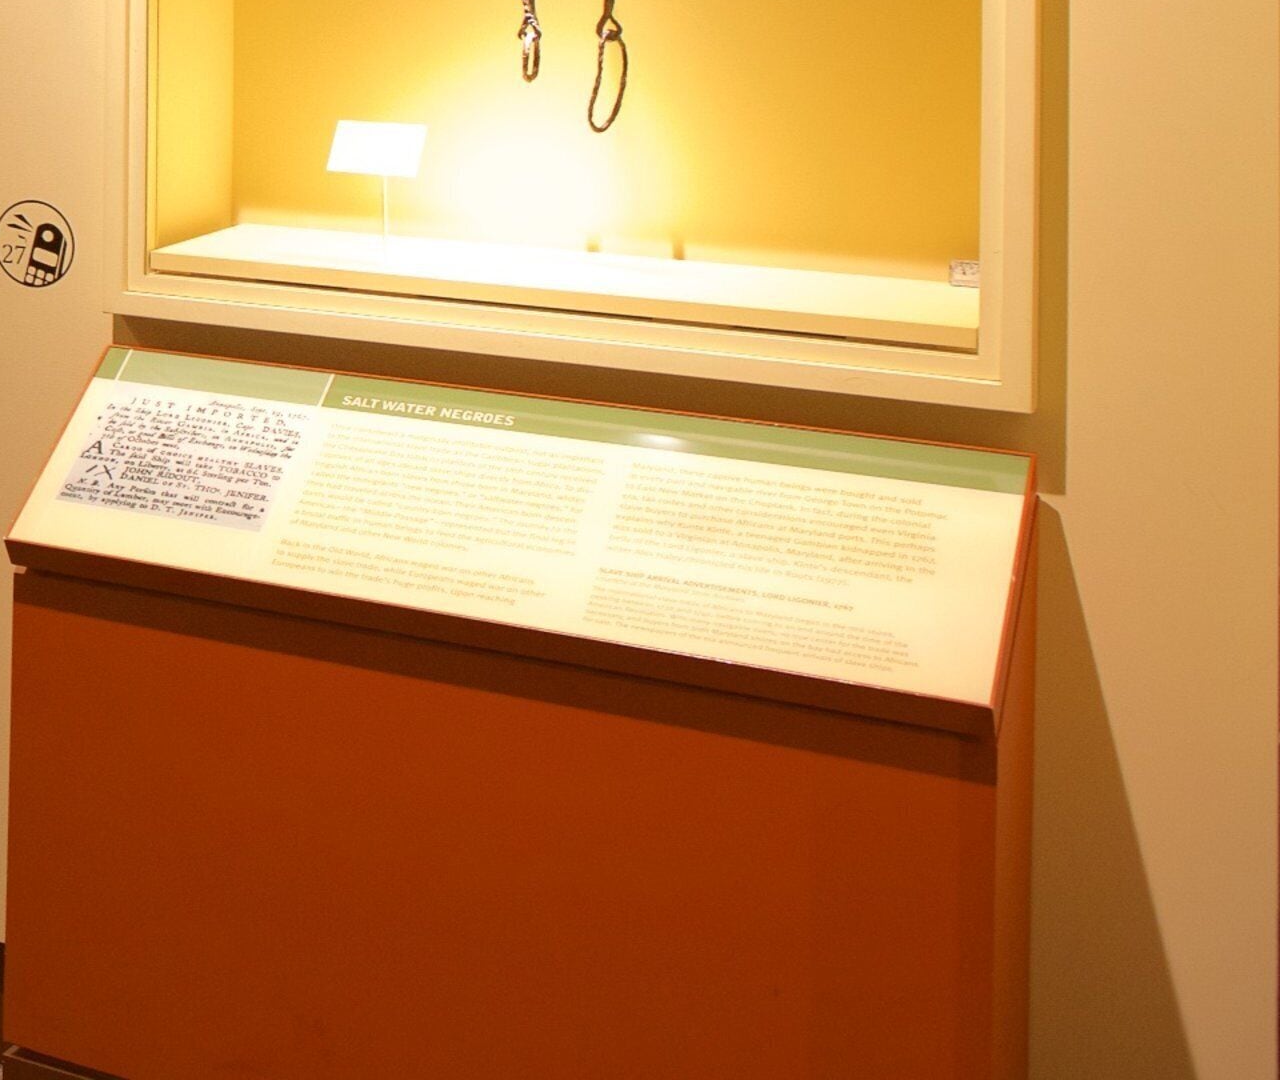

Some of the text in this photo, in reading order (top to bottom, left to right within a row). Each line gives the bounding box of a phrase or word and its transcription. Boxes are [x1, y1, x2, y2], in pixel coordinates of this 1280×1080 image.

[2, 244, 26, 264] 27
[342, 395, 516, 427] SALT WATER NEGROES
[120, 473, 159, 485] DANIEL
[124, 466, 152, 476] JOHN
